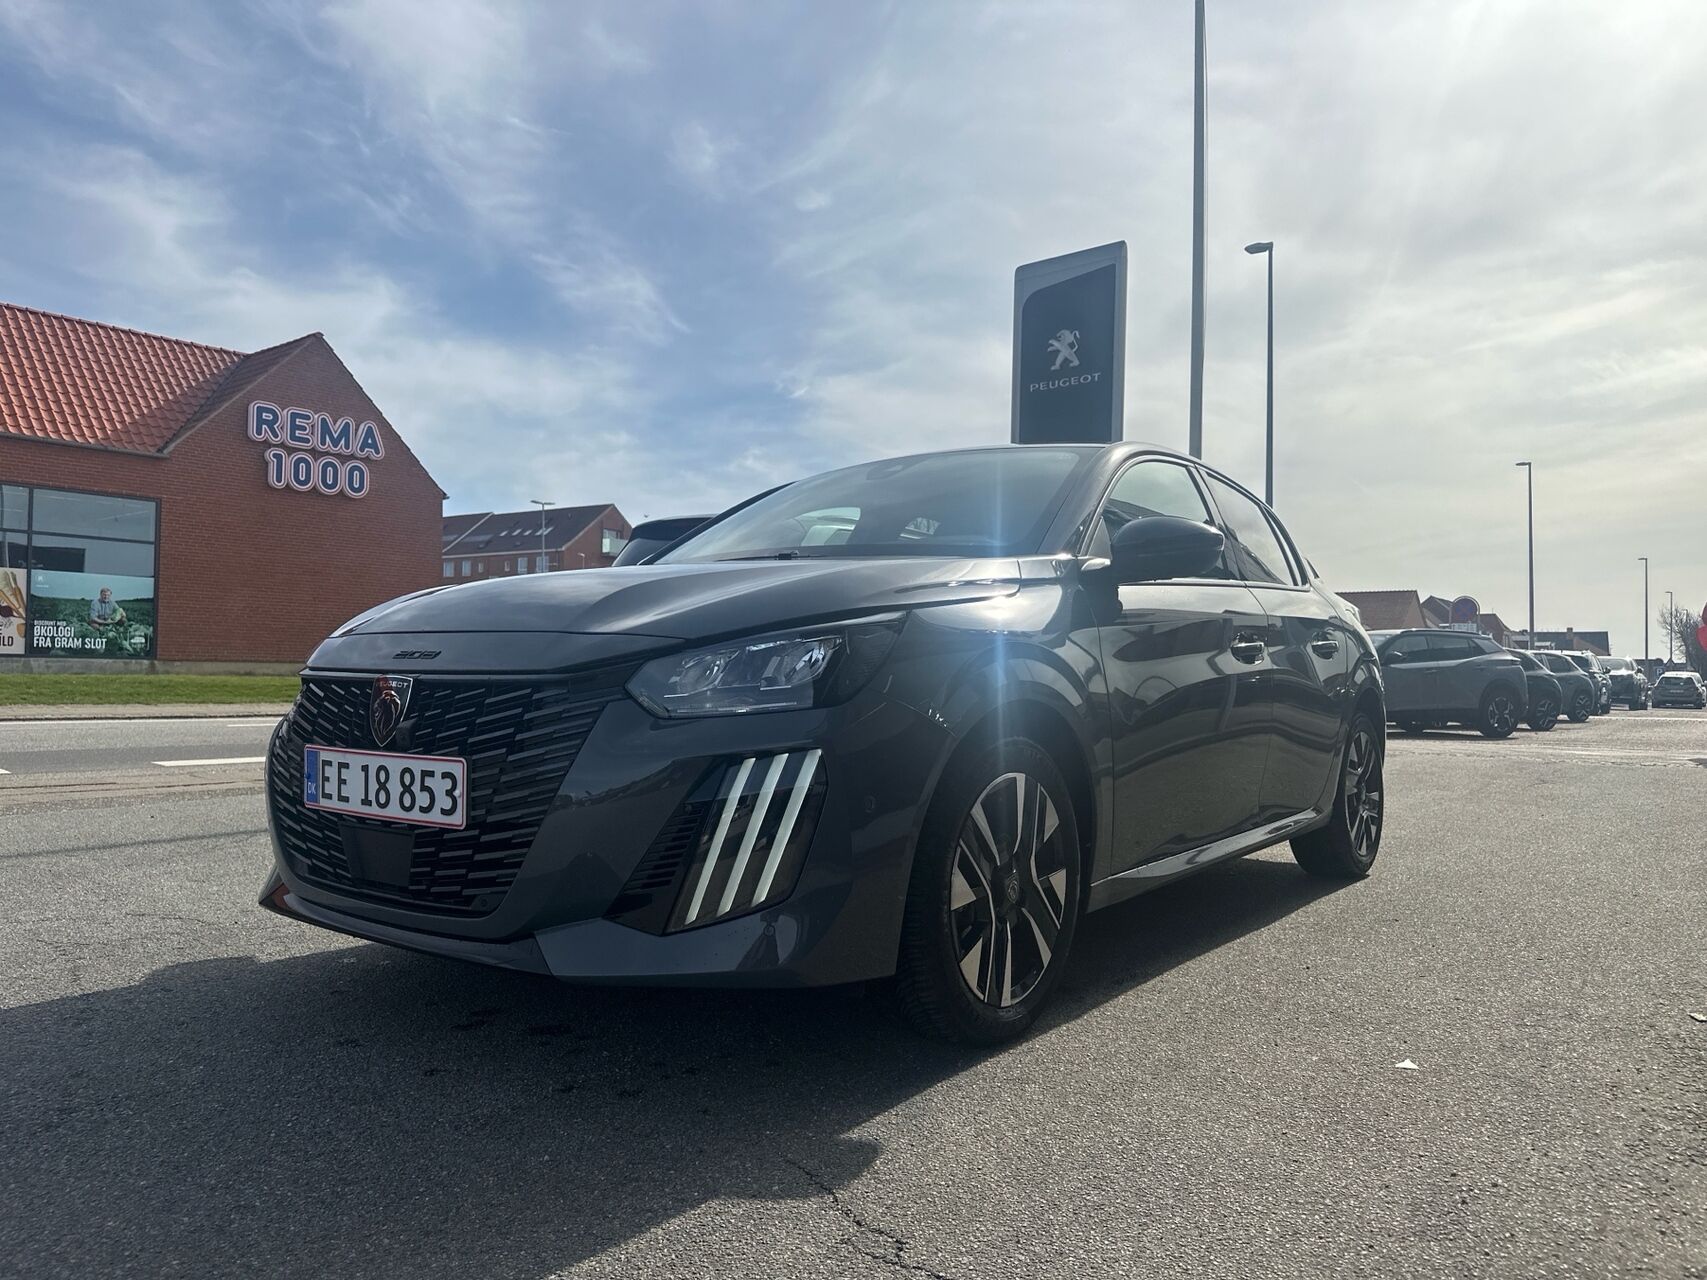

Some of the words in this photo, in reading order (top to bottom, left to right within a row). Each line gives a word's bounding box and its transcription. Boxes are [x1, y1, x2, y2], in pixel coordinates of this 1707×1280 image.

[1030, 372, 1101, 392] PEUGEOT
[250, 402, 383, 458] REMA
[266, 450, 368, 496] 1000
[34, 626, 74, 637] ØKOLOGI
[33, 636, 52, 648] FRA
[55, 637, 82, 649] GRAM
[85, 638, 108, 649] SLOT
[392, 650, 442, 660] 208
[307, 781, 317, 795] DK
[321, 759, 350, 803] EE
[361, 763, 391, 809] 18
[399, 766, 458, 816] 853
